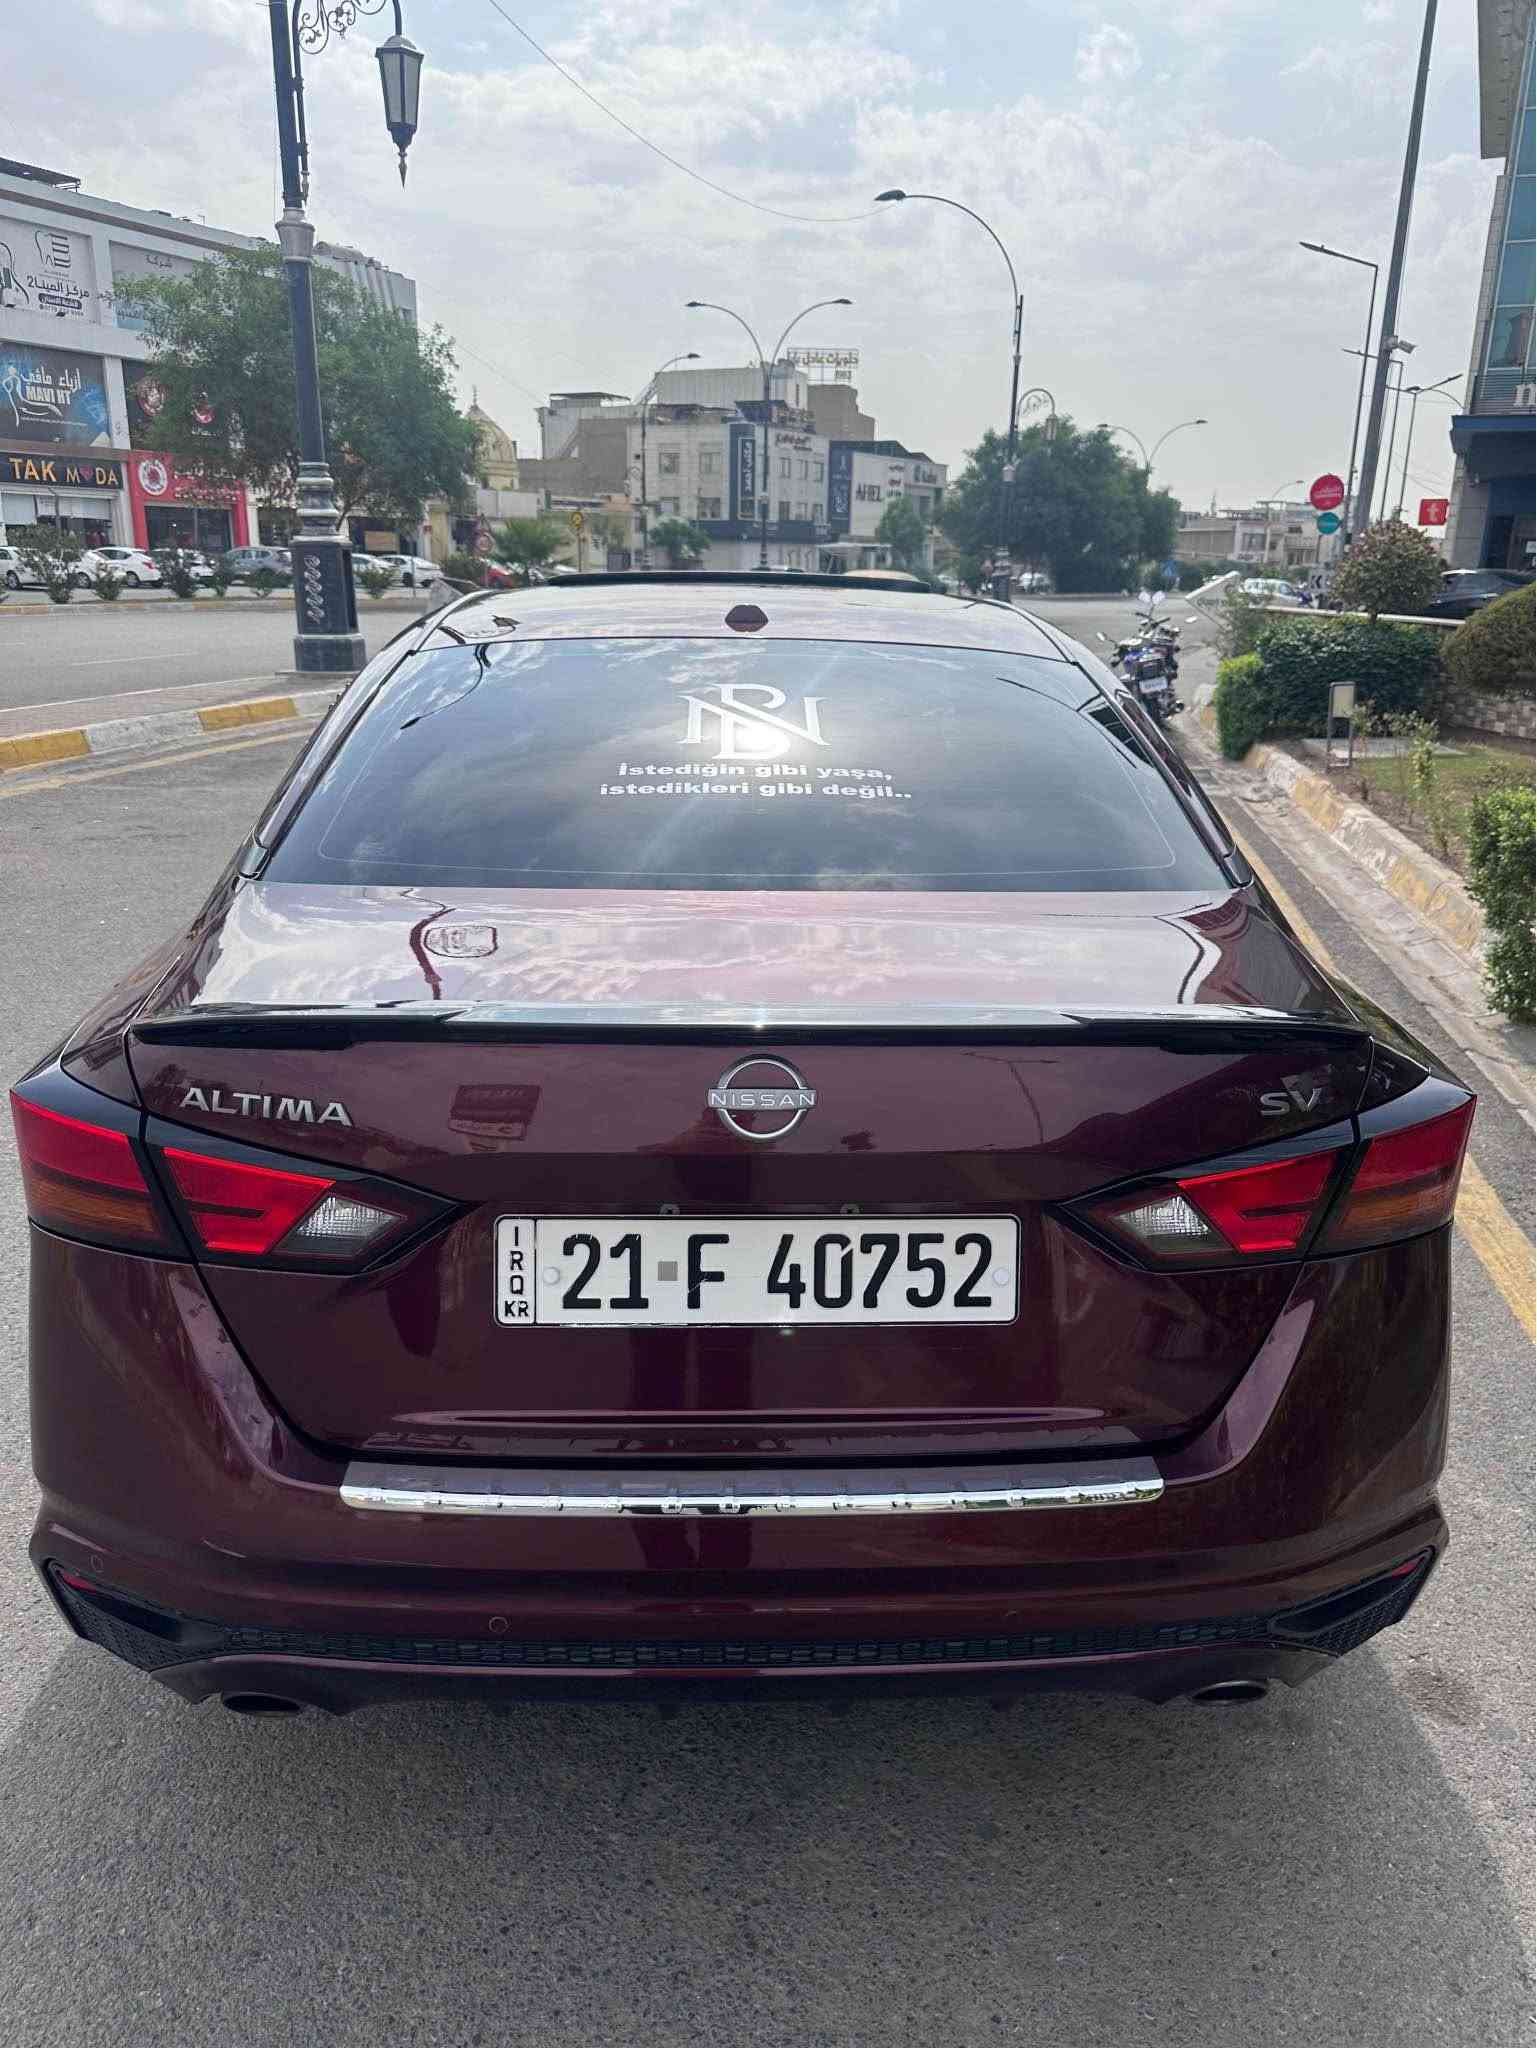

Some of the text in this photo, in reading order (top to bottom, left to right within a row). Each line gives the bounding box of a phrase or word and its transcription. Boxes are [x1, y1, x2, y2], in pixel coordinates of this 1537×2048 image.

[9, 457, 57, 482] TAK
[754, 764, 808, 779] gibi
[816, 766, 893, 781] yaşa,
[600, 783, 750, 796] istedikleri
[759, 783, 813, 797] gibi
[179, 1087, 353, 1127] ALTIMA
[711, 1093, 816, 1107] NISSAN
[1260, 1086, 1322, 1116] SV
[562, 1232, 993, 1310] 21 F 40752
[503, 1299, 530, 1318] KR
